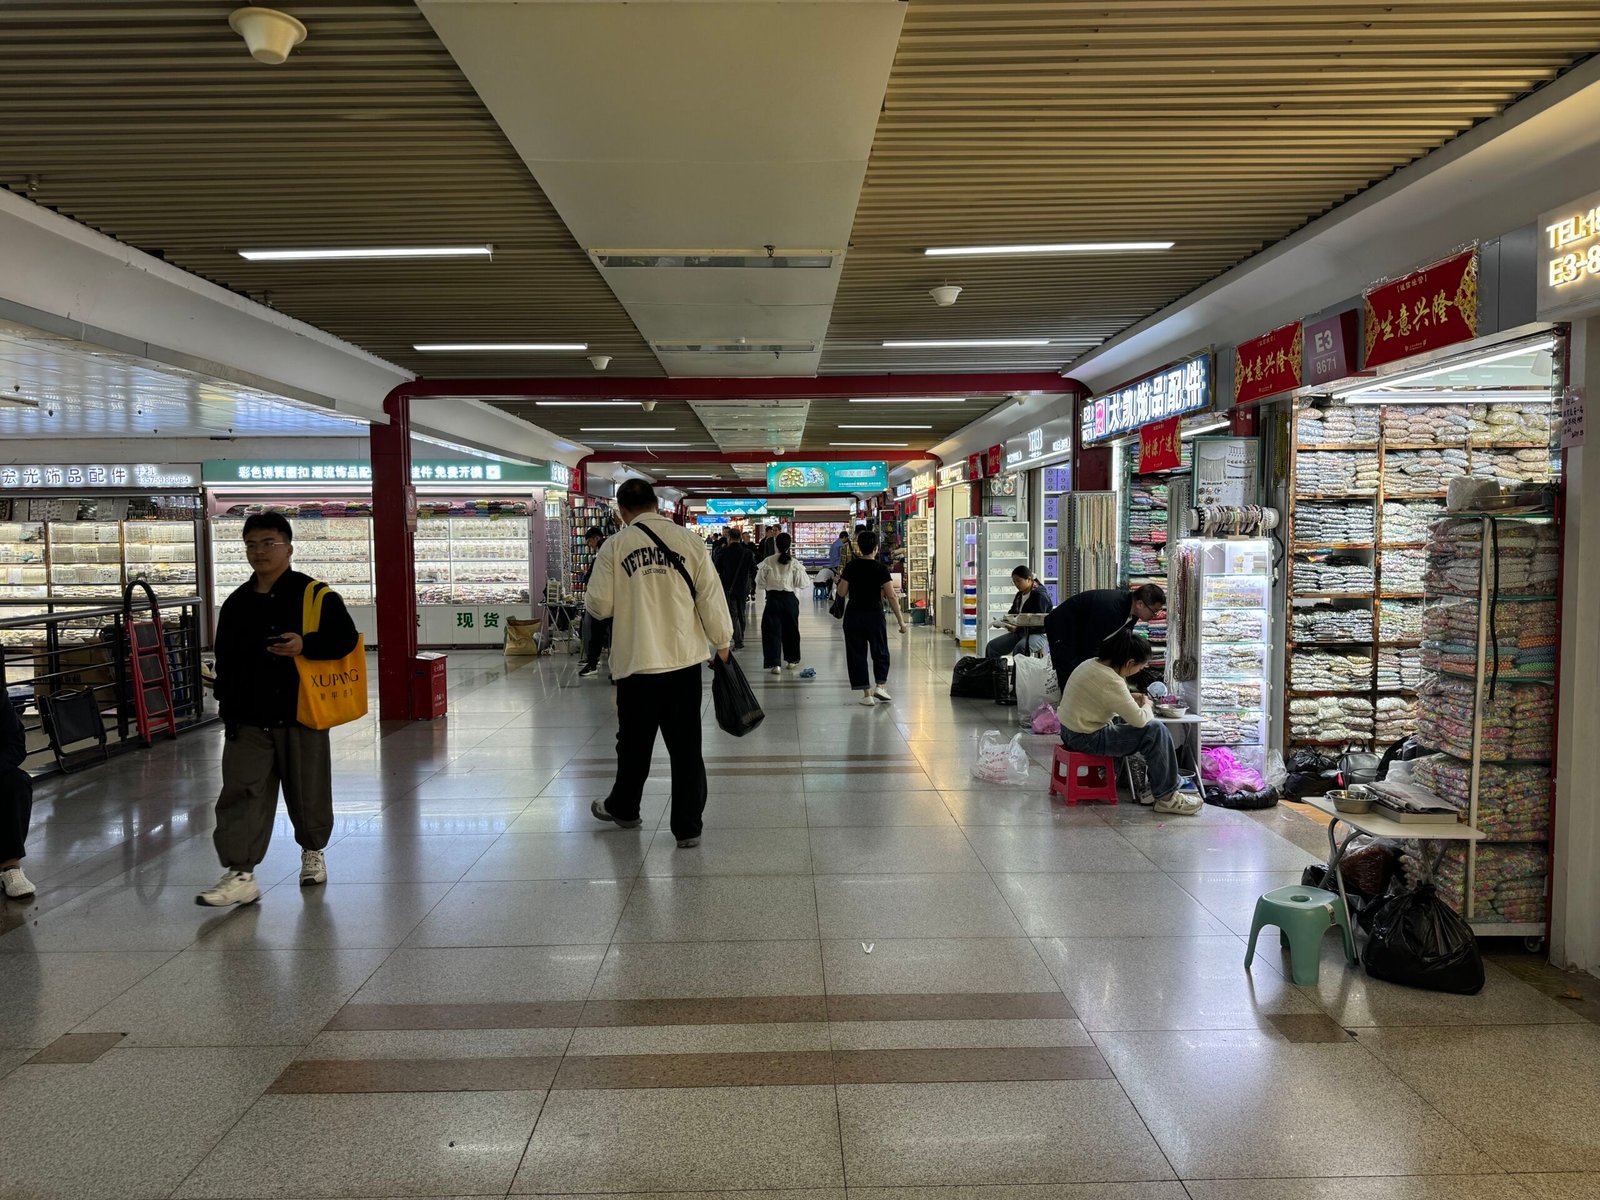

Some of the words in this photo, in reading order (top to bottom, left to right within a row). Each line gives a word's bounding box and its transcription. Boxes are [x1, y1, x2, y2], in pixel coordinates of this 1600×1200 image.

[1381, 289, 1453, 341] 生意兴隆
[1314, 329, 1334, 353] E3
[1245, 347, 1288, 383] 生意兴隆
[1316, 356, 1337, 375] 8671
[1144, 433, 1174, 459] 财源广进
[1, 468, 126, 483] 宏光饰品配件
[457, 612, 499, 628] 现货
